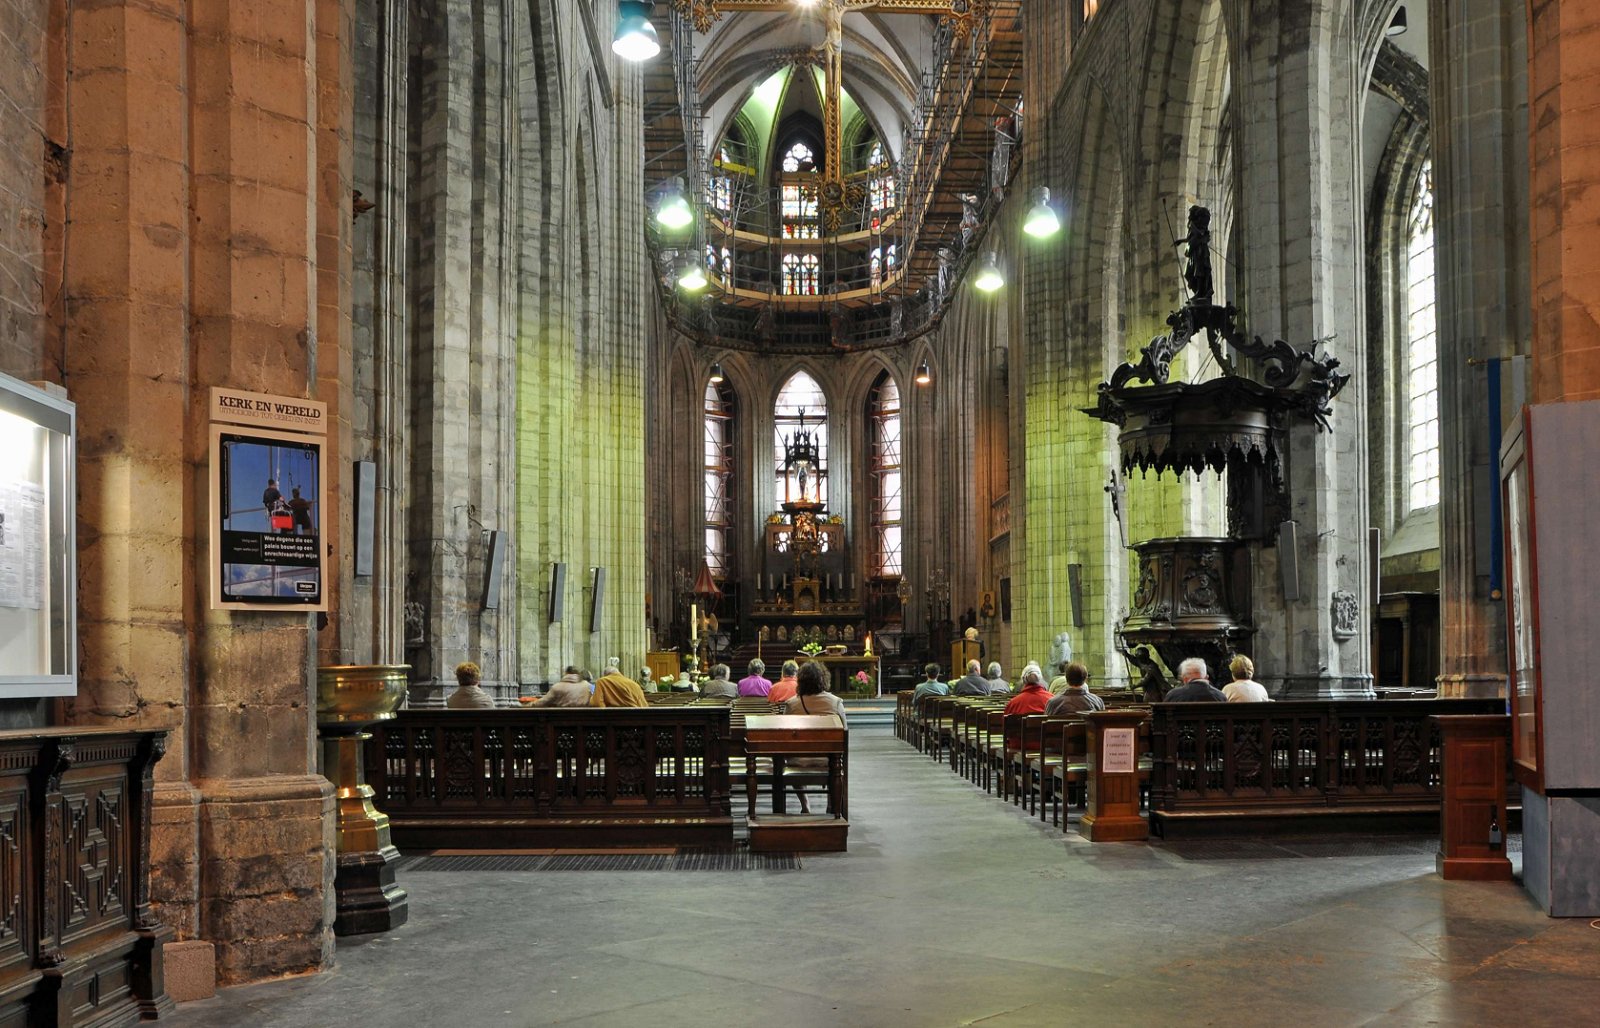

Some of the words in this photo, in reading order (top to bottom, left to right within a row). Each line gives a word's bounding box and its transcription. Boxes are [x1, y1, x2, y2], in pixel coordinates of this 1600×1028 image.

[219, 396, 253, 410] KERK
[255, 401, 271, 412] EN
[274, 403, 321, 418] WERELD
[260, 412, 273, 420] TOT
